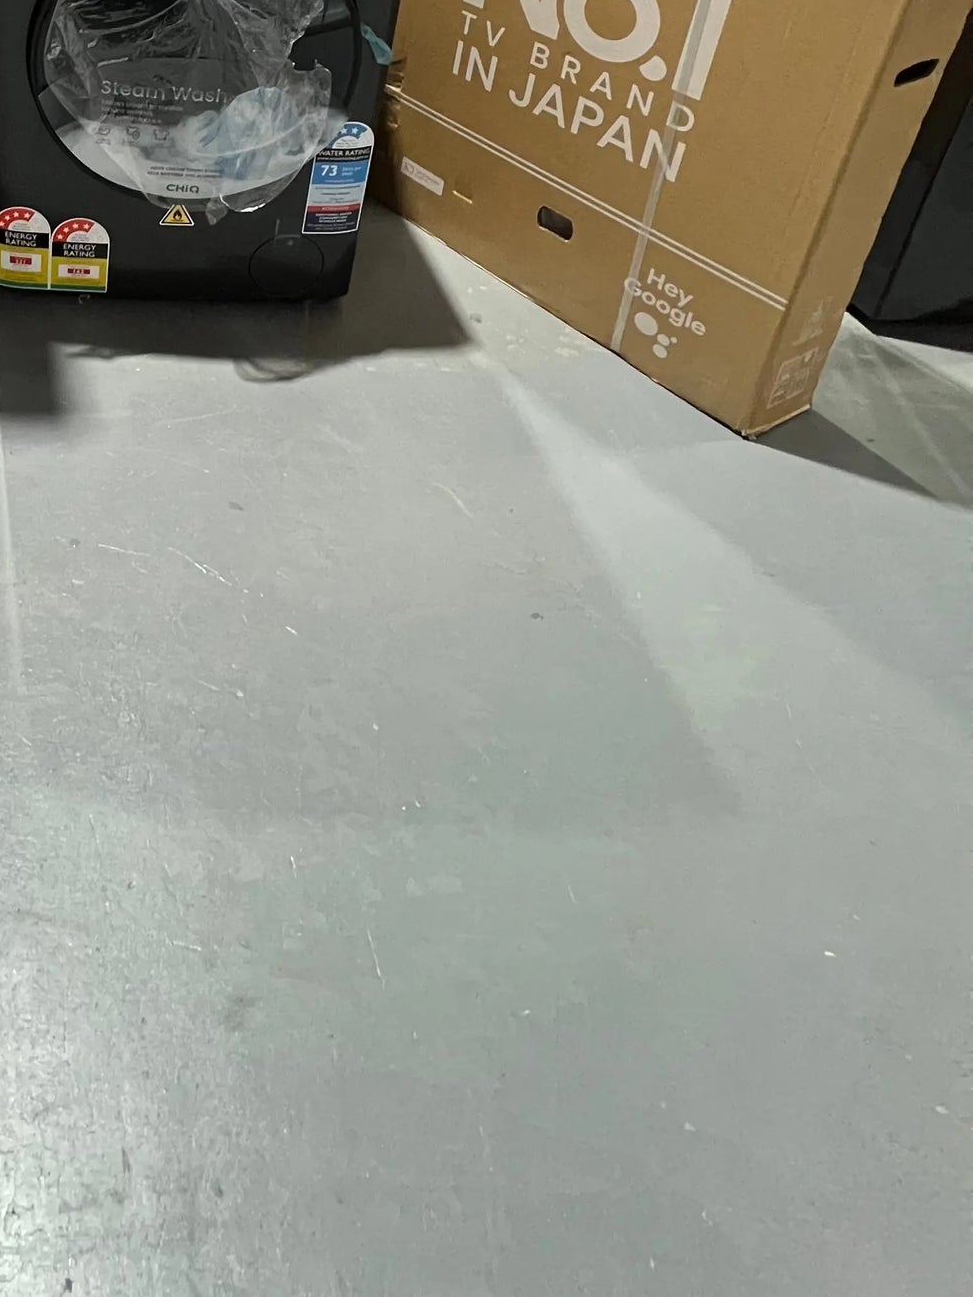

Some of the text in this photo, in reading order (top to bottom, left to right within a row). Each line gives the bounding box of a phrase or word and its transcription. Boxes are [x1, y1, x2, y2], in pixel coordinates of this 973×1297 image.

[460, 10, 695, 133] TV BRAND
[101, 80, 227, 103] Steam Wash
[452, 40, 686, 183] IN JAPAN
[318, 147, 370, 157] WATER RATING
[321, 165, 338, 177] 73
[4, 231, 37, 241] ENERGY
[5, 239, 37, 247] RATING
[63, 243, 96, 251] ENERGY
[63, 250, 95, 258] RATING
[646, 268, 694, 306] Hey
[624, 277, 707, 336] Google
